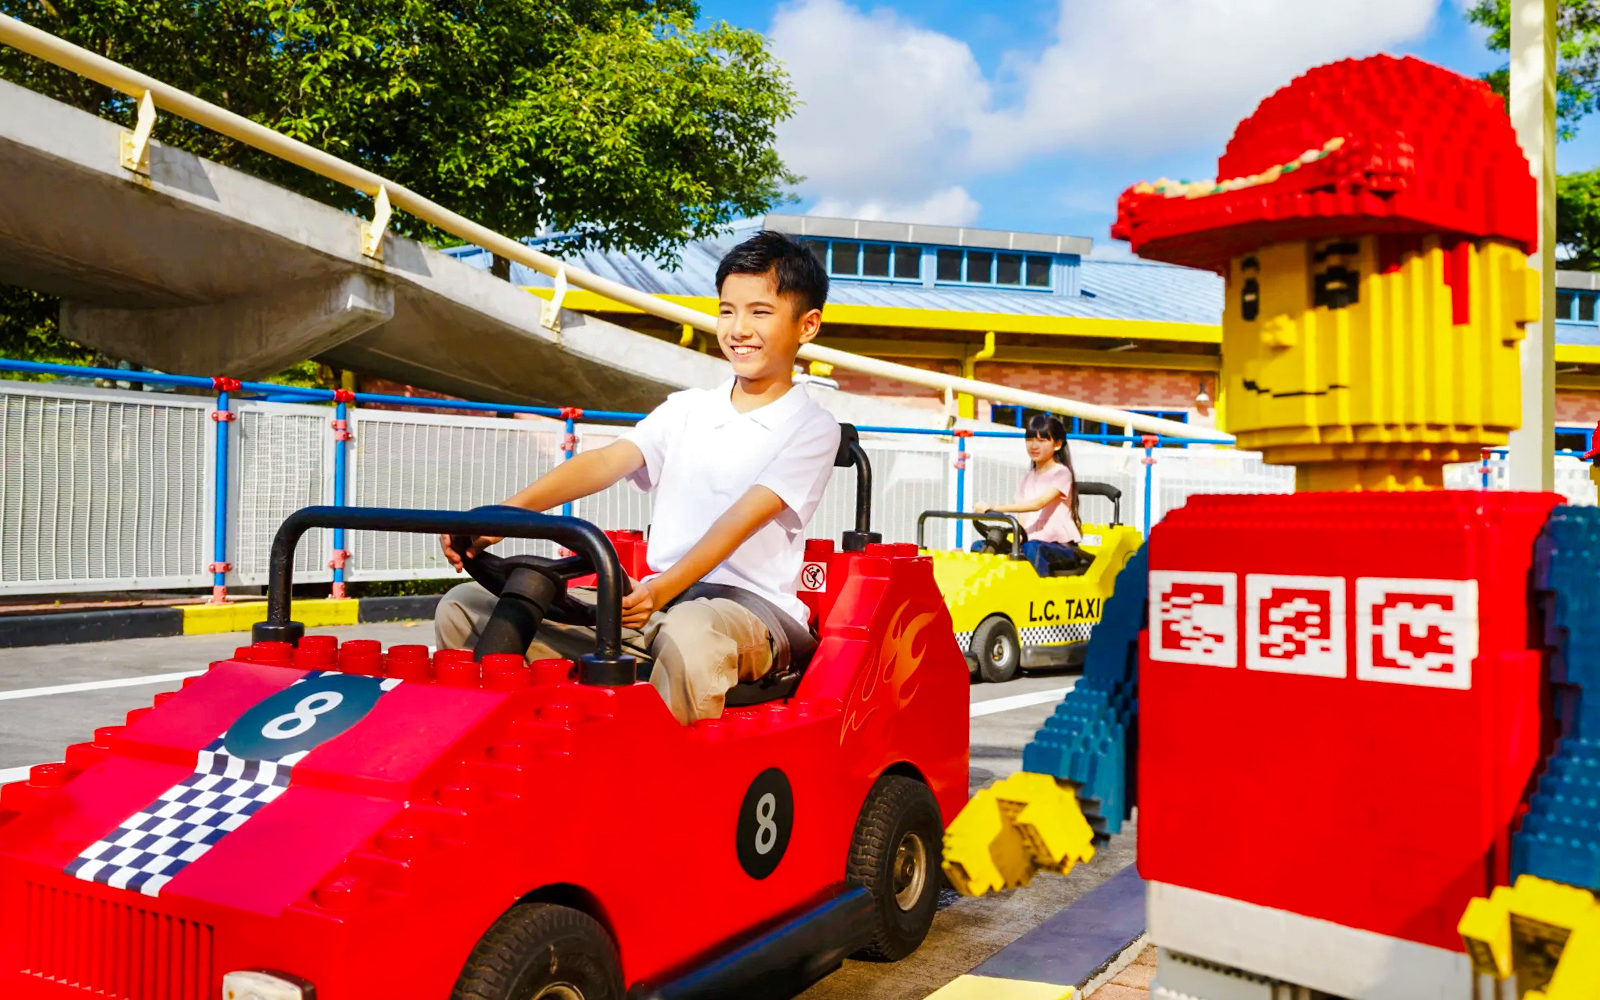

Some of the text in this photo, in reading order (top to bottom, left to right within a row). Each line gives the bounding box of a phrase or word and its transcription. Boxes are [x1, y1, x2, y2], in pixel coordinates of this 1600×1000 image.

[1029, 598, 1101, 622] L.C. TAXI
[261, 690, 344, 740] 8
[754, 792, 778, 855] 8
